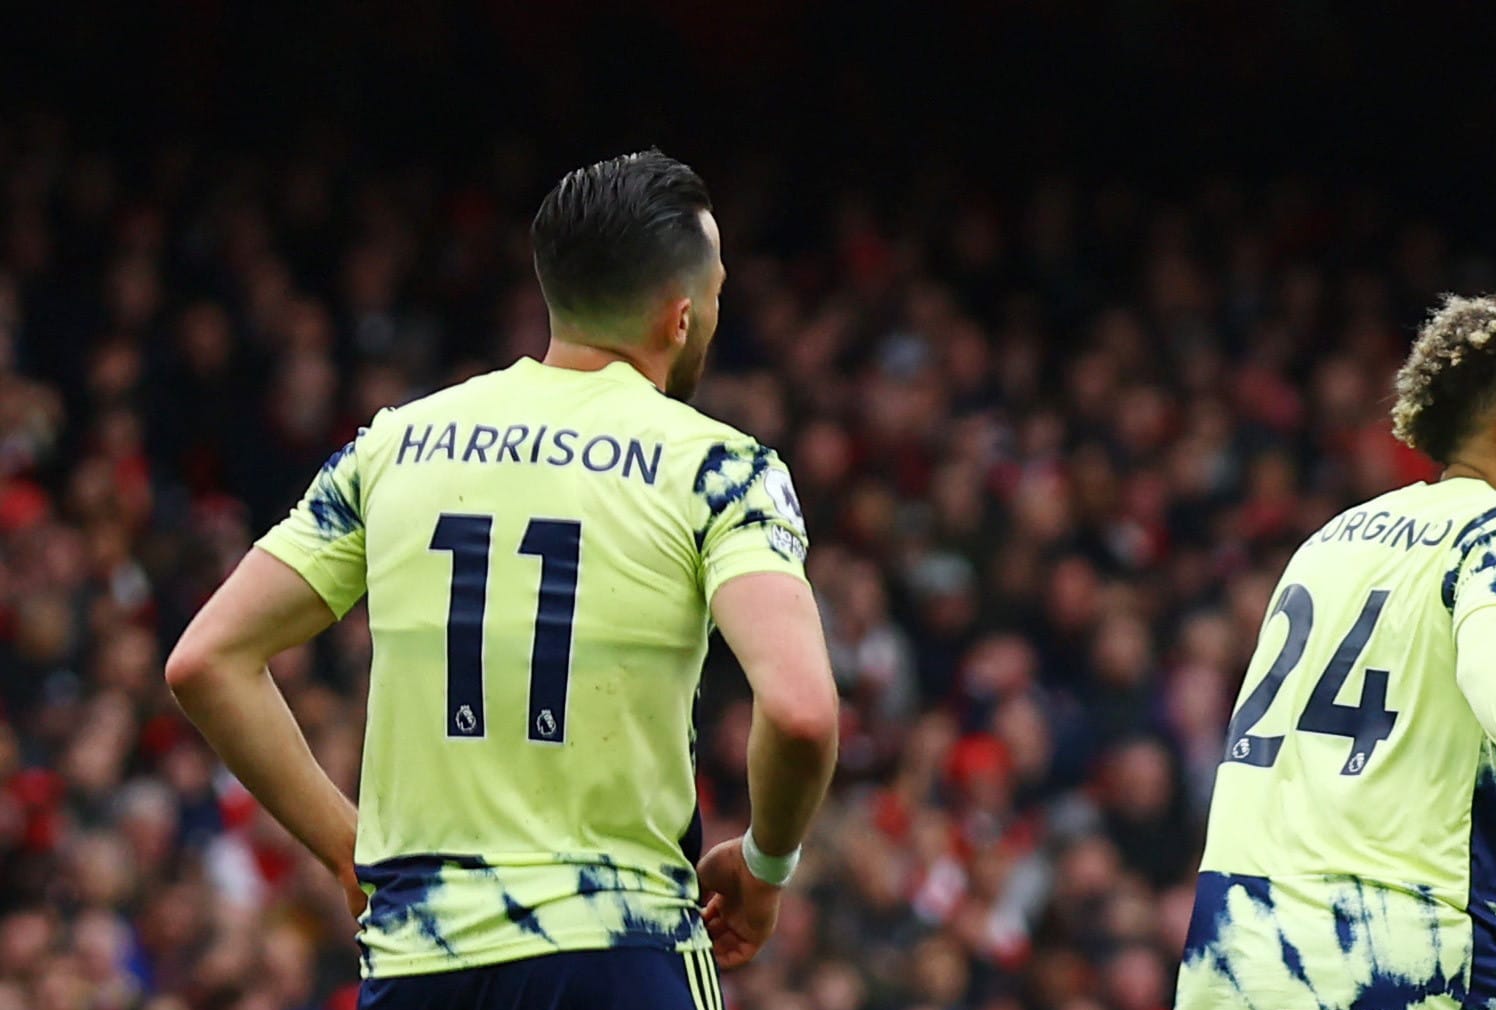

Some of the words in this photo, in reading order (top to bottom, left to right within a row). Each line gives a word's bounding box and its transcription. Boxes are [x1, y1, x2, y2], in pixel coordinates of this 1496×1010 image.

[395, 422, 664, 486] HARRISON
[428, 512, 582, 745] 11
[1223, 583, 1398, 776] 24
